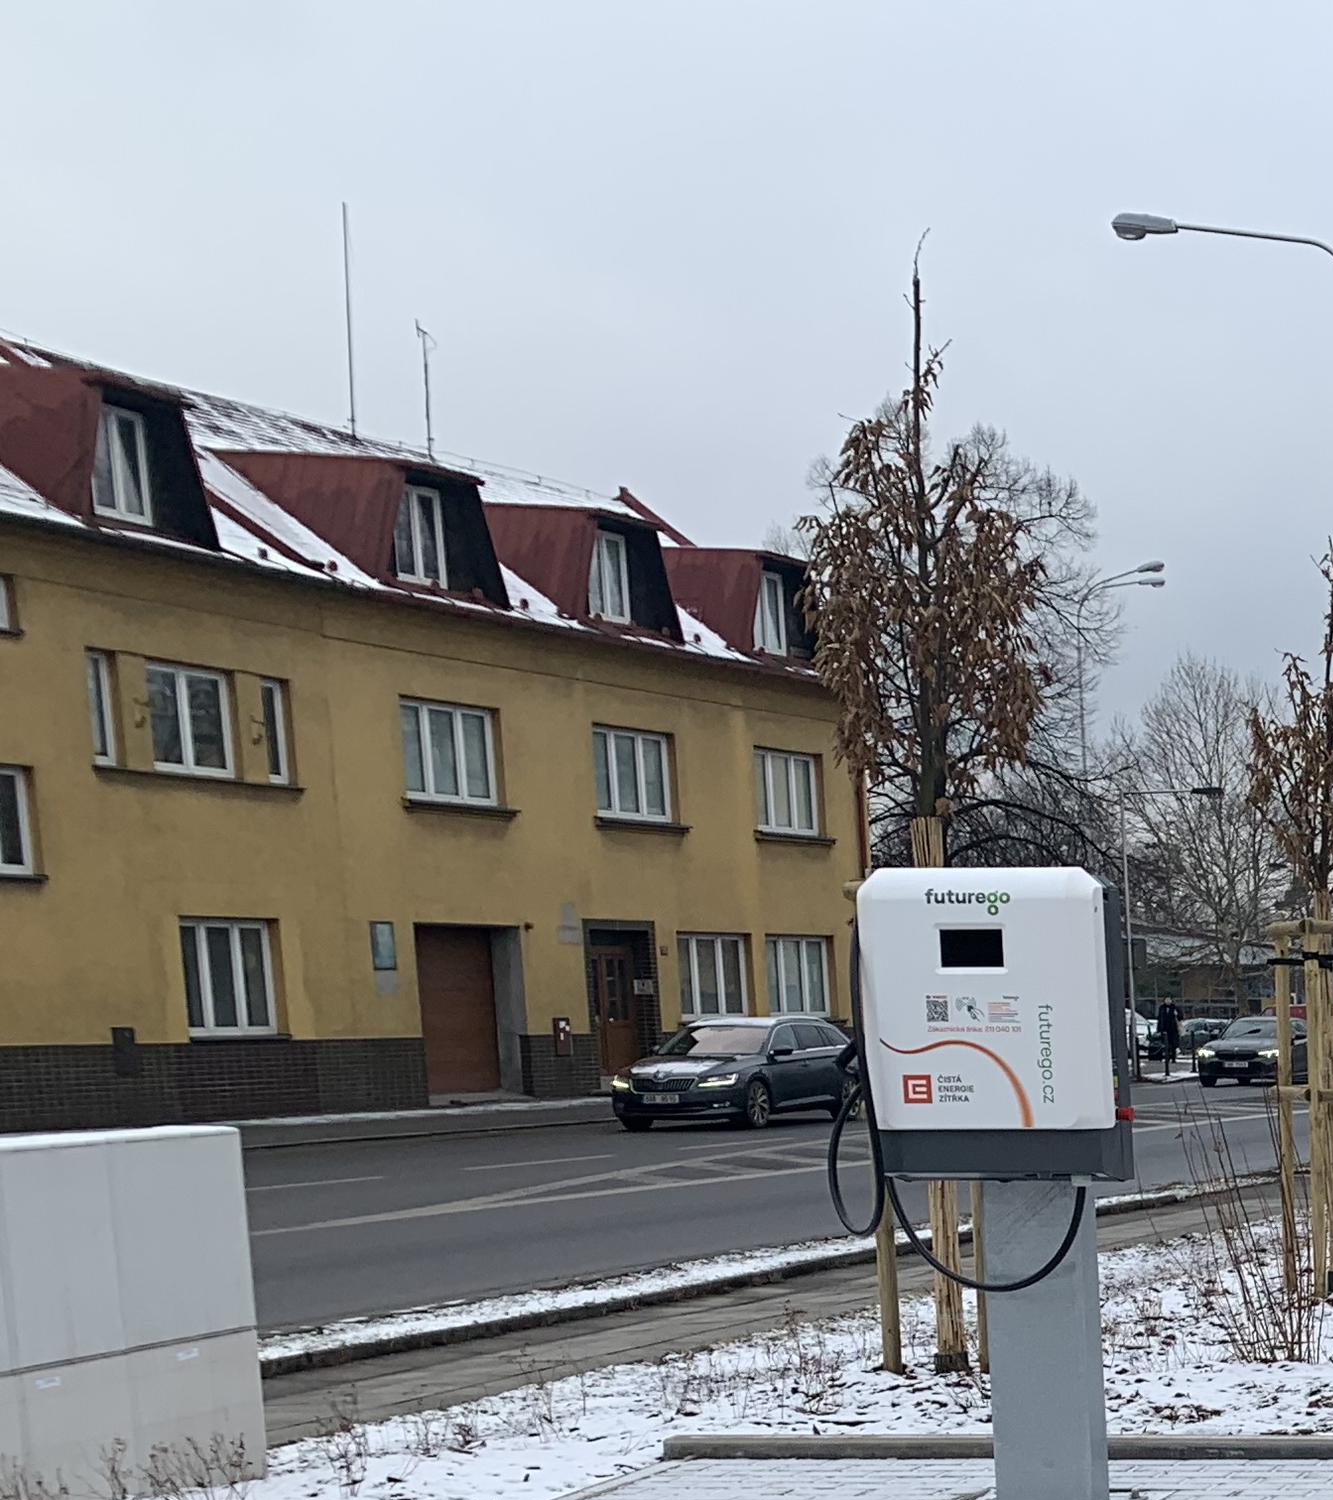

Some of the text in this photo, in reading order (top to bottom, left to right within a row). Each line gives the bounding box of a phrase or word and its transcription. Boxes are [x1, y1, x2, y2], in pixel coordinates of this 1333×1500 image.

[924, 888, 1011, 916] futurego
[1037, 1003, 1055, 1104] futurego.cz
[937, 1074, 962, 1083] ČISTÁ
[938, 1085, 974, 1093] ENERGIE
[938, 1093, 970, 1103] ZÍTŘKA
